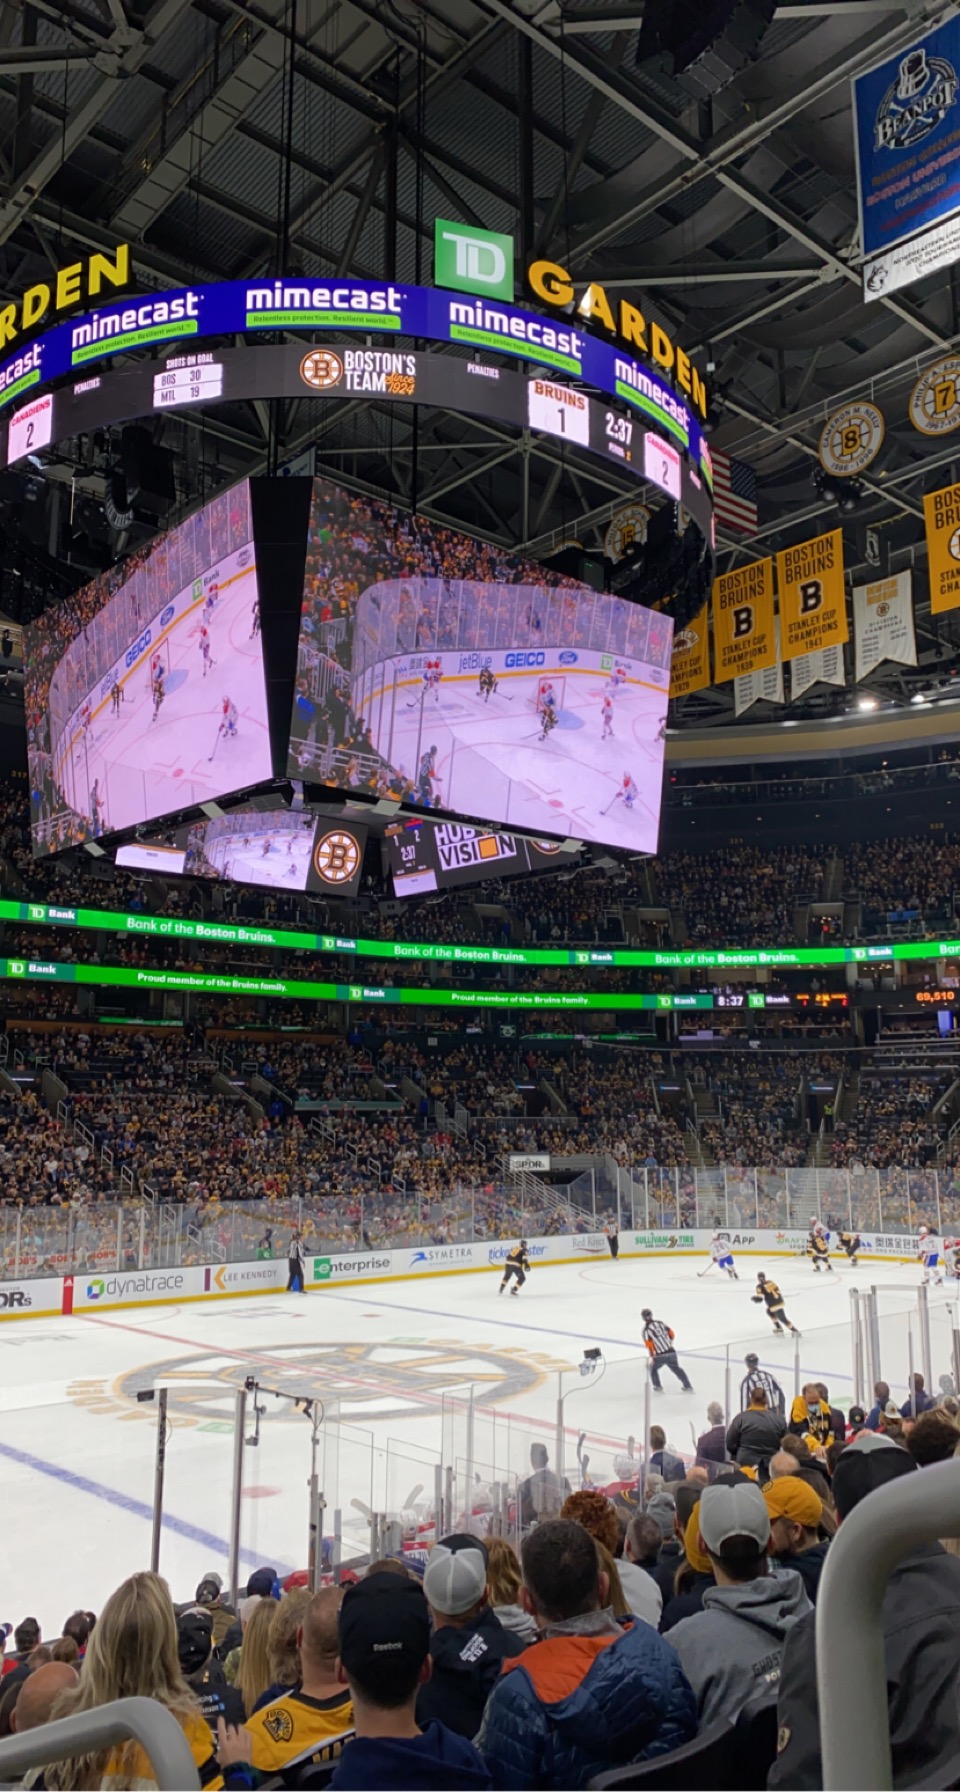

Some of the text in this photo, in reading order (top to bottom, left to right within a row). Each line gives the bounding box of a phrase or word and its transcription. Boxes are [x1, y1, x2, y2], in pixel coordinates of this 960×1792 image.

[874, 78, 956, 151] BEANPOT
[443, 233, 506, 285] TD
[247, 281, 402, 313] mimecast
[73, 292, 199, 348] mimecast
[450, 301, 583, 360] mimecast
[528, 260, 707, 420] GARDEN
[166, 352, 213, 369] SHOTS ON GOAL
[344, 351, 416, 376] BOSTON'S
[467, 362, 500, 380] PENALTIES
[161, 370, 201, 386] BOS 30
[345, 371, 386, 392] TEAM
[386, 380, 415, 396] 1924
[161, 387, 200, 402] MTL 19
[534, 379, 586, 411] BRUINS
[615, 358, 690, 433] mimecast
[938, 385, 952, 406] 7
[11, 402, 51, 430] CANADIENS
[557, 408, 566, 433] 1
[26, 422, 34, 449] 2
[605, 412, 633, 446] 2:37
[822, 410, 851, 448] CAMERON
[864, 408, 881, 429] NEELY
[844, 430, 857, 449] 8
[661, 460, 669, 486] 2
[784, 535, 834, 568] BOSTON
[719, 562, 765, 595] BOSTON
[785, 552, 835, 585] BRUINS
[719, 581, 765, 611] BRUINS
[800, 581, 822, 613] B
[733, 605, 753, 639] B
[788, 609, 837, 634] STANLEY CUP
[788, 620, 838, 645] CHAMPIONS
[125, 629, 152, 670] GEICO
[722, 633, 767, 657] STANLEY CUP
[458, 652, 493, 674] jetBlue
[505, 652, 546, 668] GEICO
[689, 655, 703, 669] CUP
[722, 644, 768, 669] CHAMPIONS
[393, 835, 399, 847] 1
[414, 829, 421, 842] 2
[31, 907, 76, 920] TD Bank
[127, 917, 276, 944] Bank of the Boston Bruins.
[324, 938, 356, 950] TD Bank
[394, 945, 527, 962] Bank of the Boston Bruins.
[853, 946, 892, 959] TD Bank
[10, 962, 56, 975] TD Bank
[577, 952, 613, 964] TD Bank
[655, 951, 800, 965] Bank of the Boston Bruins.
[137, 972, 288, 993] Proud member of the Bruins family.
[350, 988, 386, 999] TD Bank
[451, 993, 590, 1007] Proud member of the Bruins family.
[660, 996, 671, 1006] TD
[673, 997, 697, 1006] Bank
[718, 995, 744, 1008] 8:37
[751, 995, 763, 1006] TD
[766, 995, 790, 1005] Bank
[916, 991, 955, 1004] 69,510
[572, 1235, 606, 1249] Red River
[635, 1235, 695, 1245] SULLIVAN TIRE
[428, 1248, 473, 1261] SYMETRA
[223, 1268, 278, 1282] LEE KENNEDY
[319, 1257, 391, 1275] enterprise
[106, 1274, 184, 1297] dynatrace
[373, 1642, 404, 1653] Reebok
